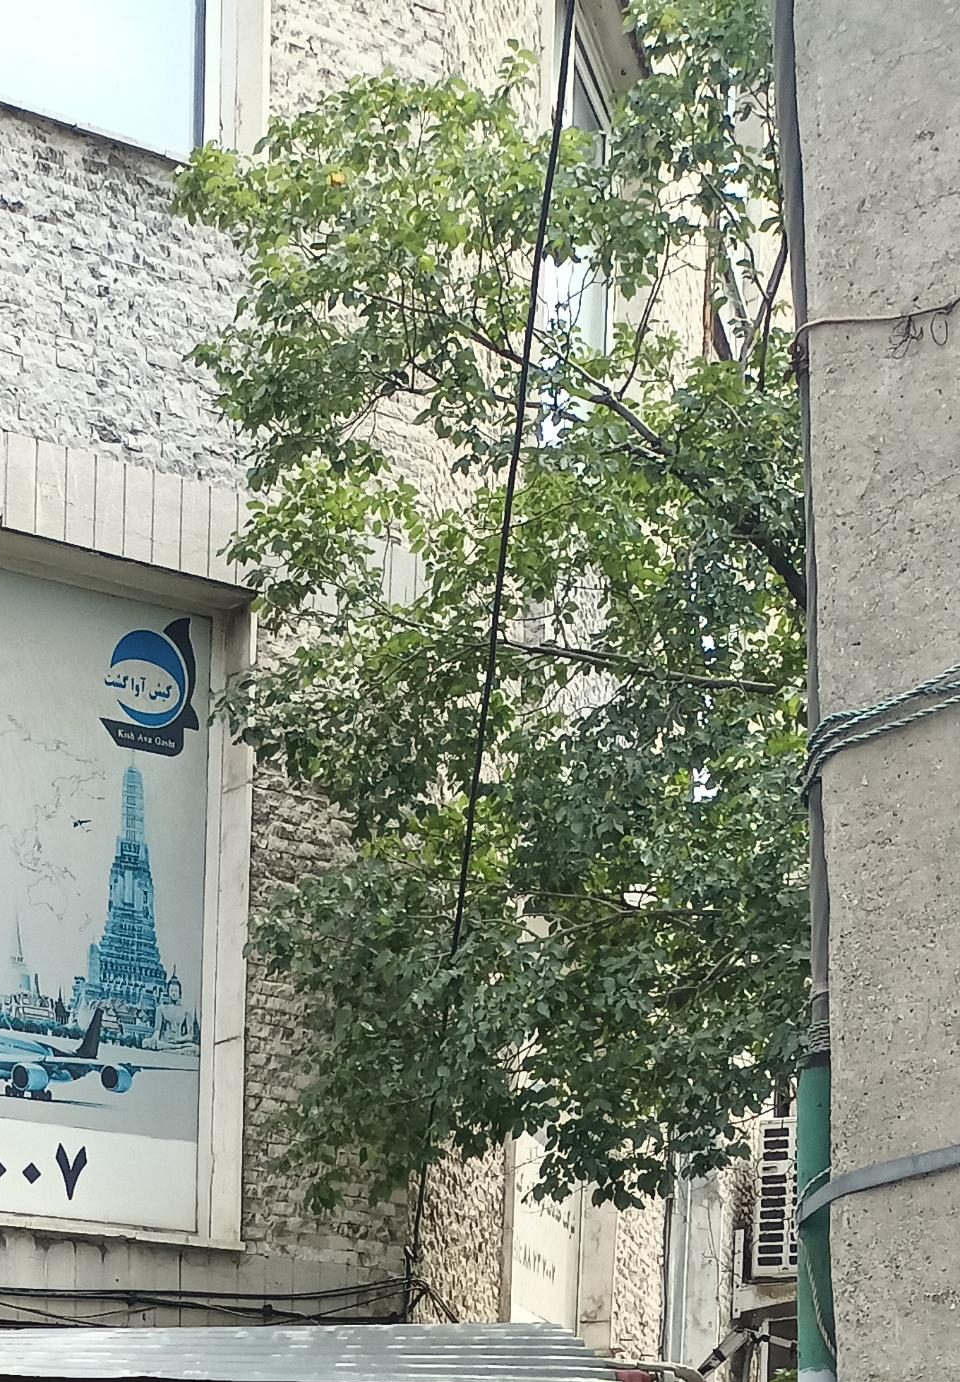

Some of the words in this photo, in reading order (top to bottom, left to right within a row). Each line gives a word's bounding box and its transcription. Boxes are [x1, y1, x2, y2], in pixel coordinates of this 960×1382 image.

[104, 674, 129, 689] گشت
[131, 677, 146, 697] آوا
[149, 683, 172, 702] کیش
[118, 729, 135, 741] Kish
[137, 733, 152, 744] Ava
